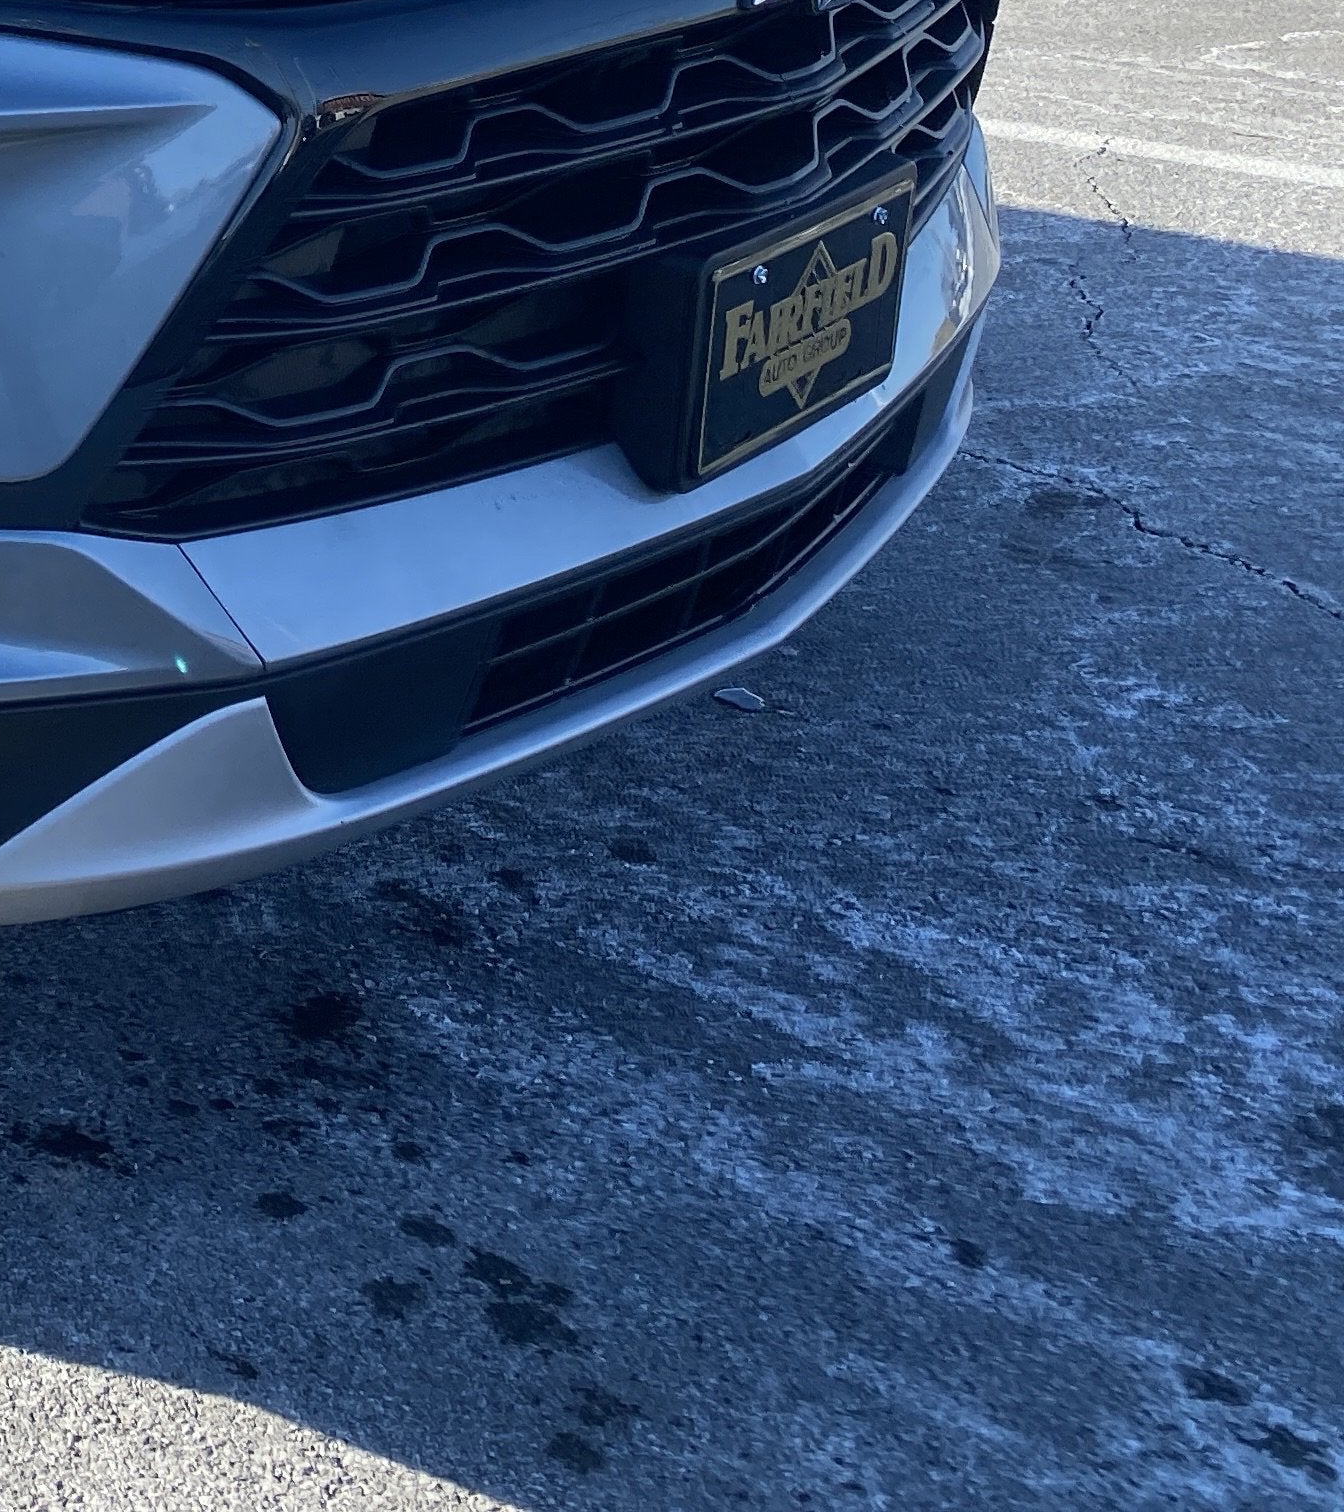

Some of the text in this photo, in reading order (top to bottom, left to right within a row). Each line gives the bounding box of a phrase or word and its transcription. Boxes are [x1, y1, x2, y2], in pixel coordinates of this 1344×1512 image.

[719, 231, 898, 382] FAIRFIELD
[763, 326, 848, 385] AUTO GROUP
